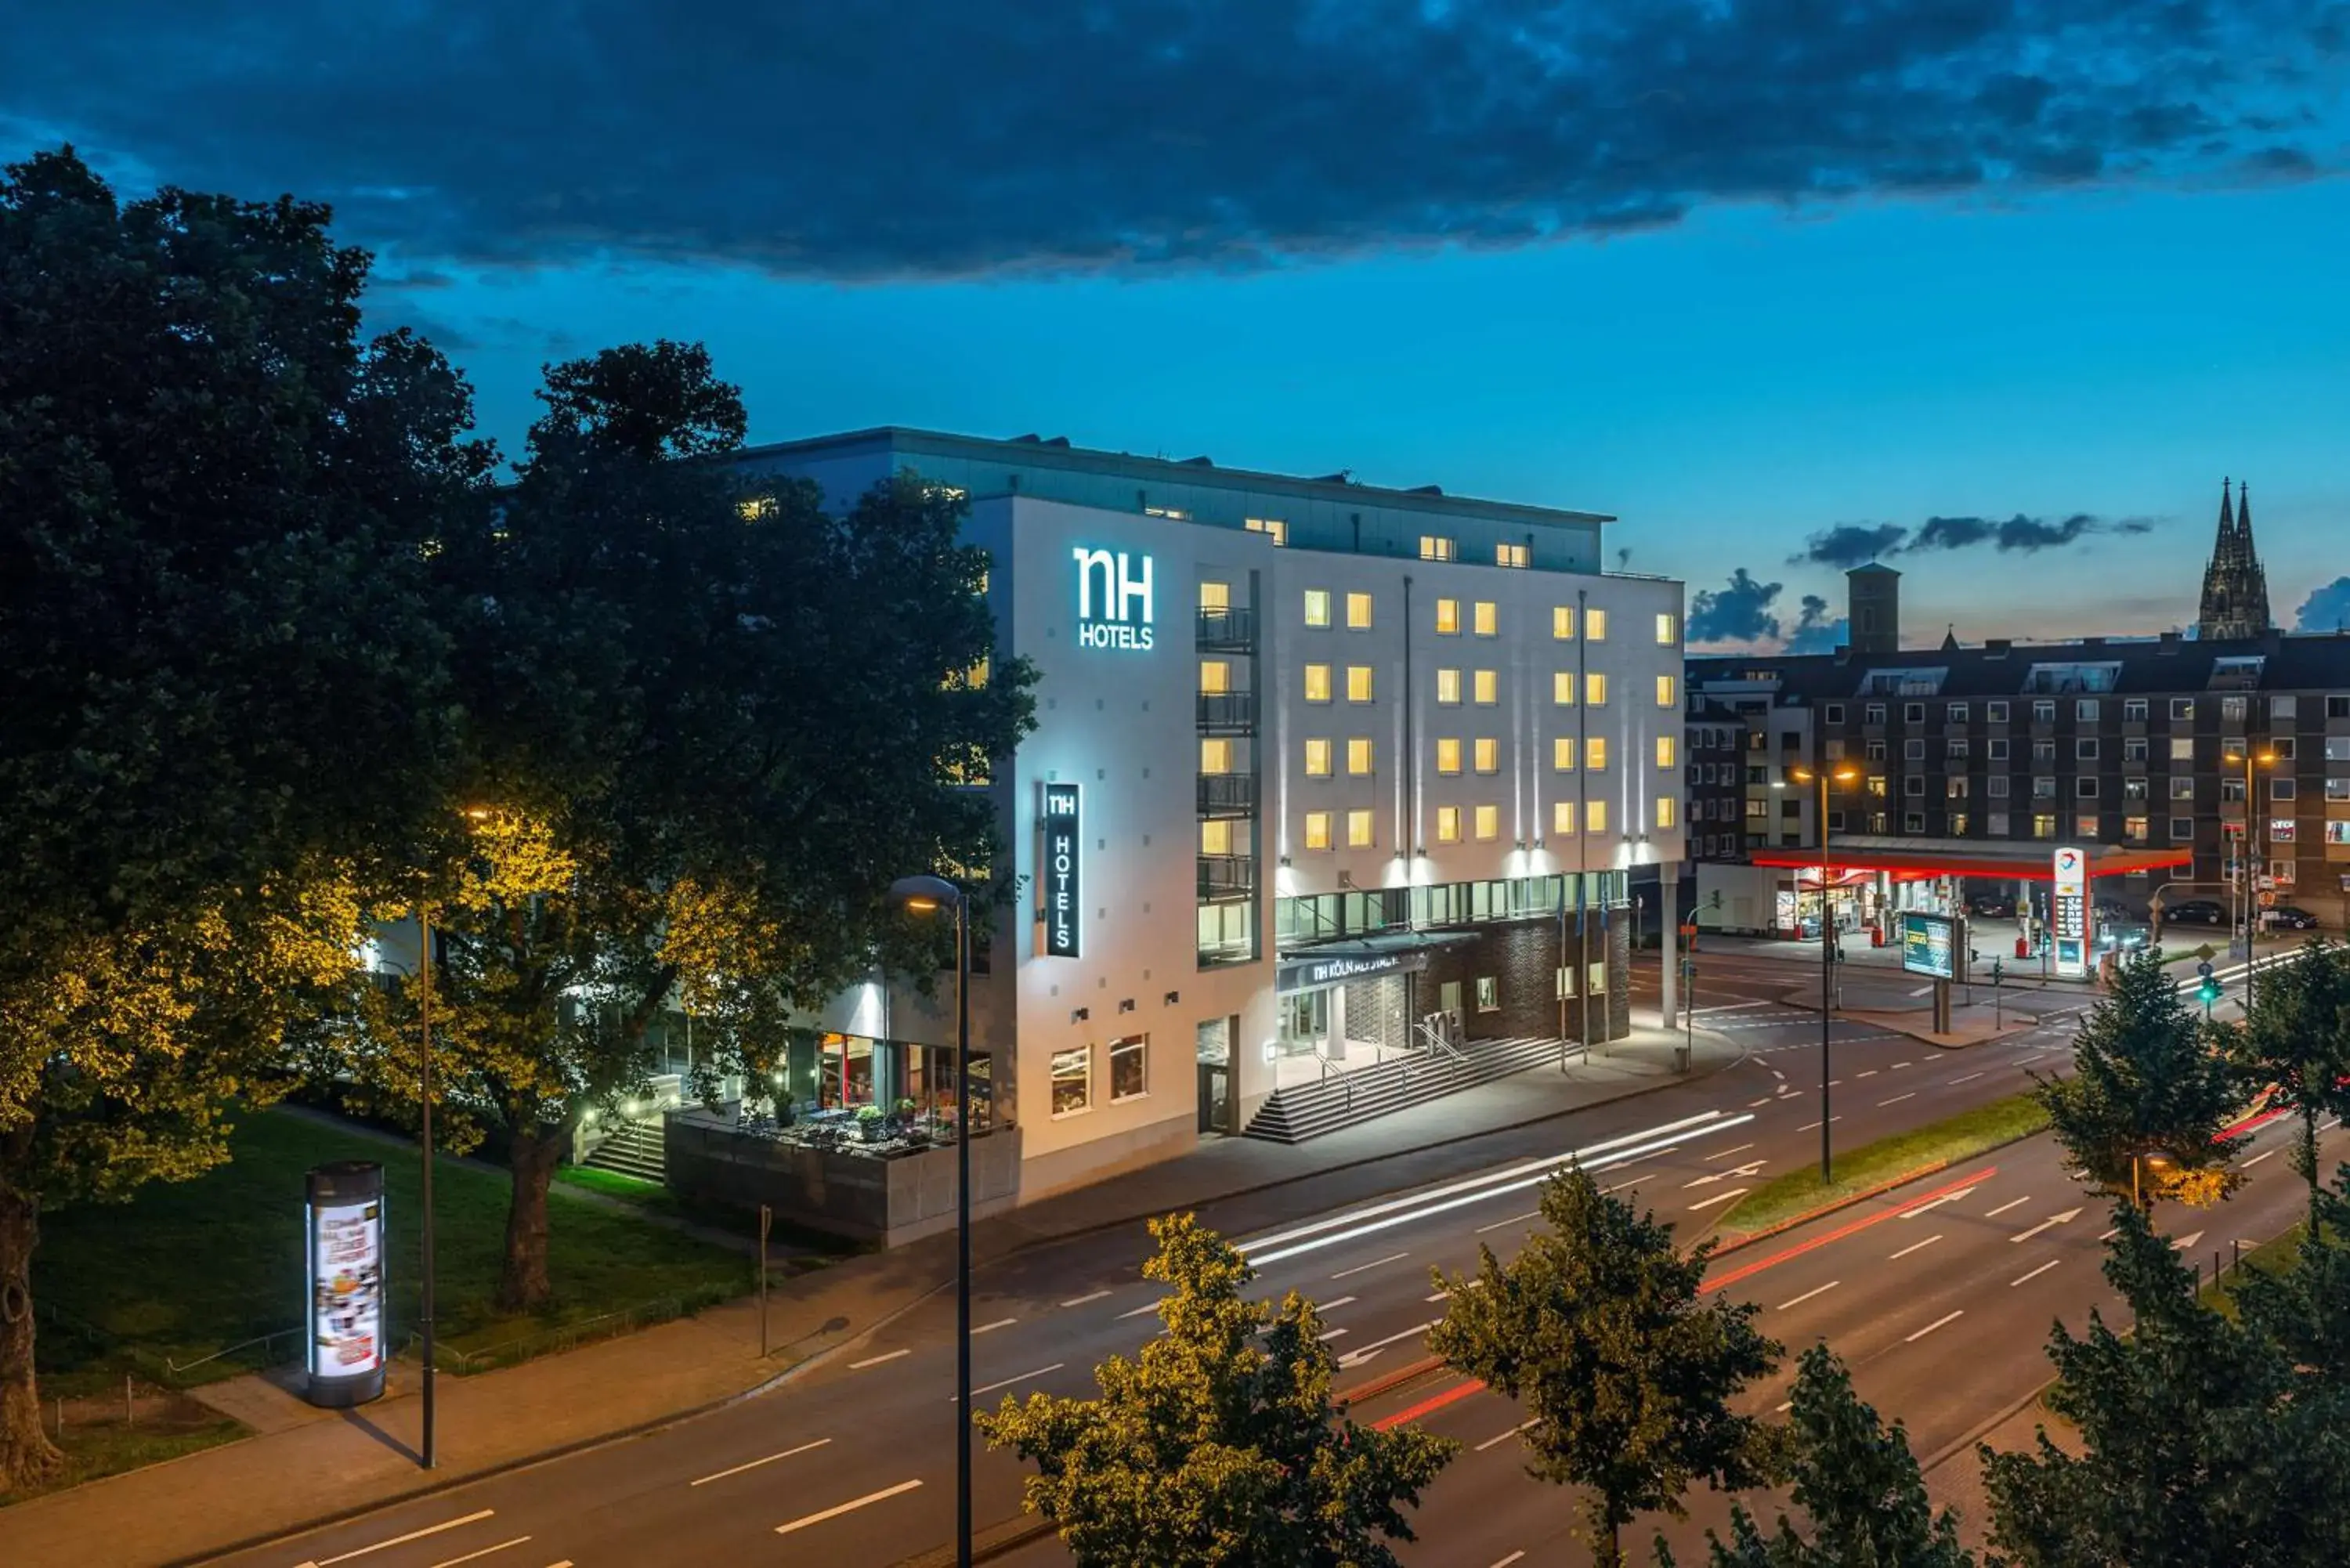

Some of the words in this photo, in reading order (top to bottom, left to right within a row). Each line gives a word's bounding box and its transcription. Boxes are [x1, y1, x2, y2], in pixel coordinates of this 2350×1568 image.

[1079, 623, 1153, 649] HOTELS
[1055, 835, 1070, 948] HOTELS
[1329, 959, 1353, 977] KÖLN
